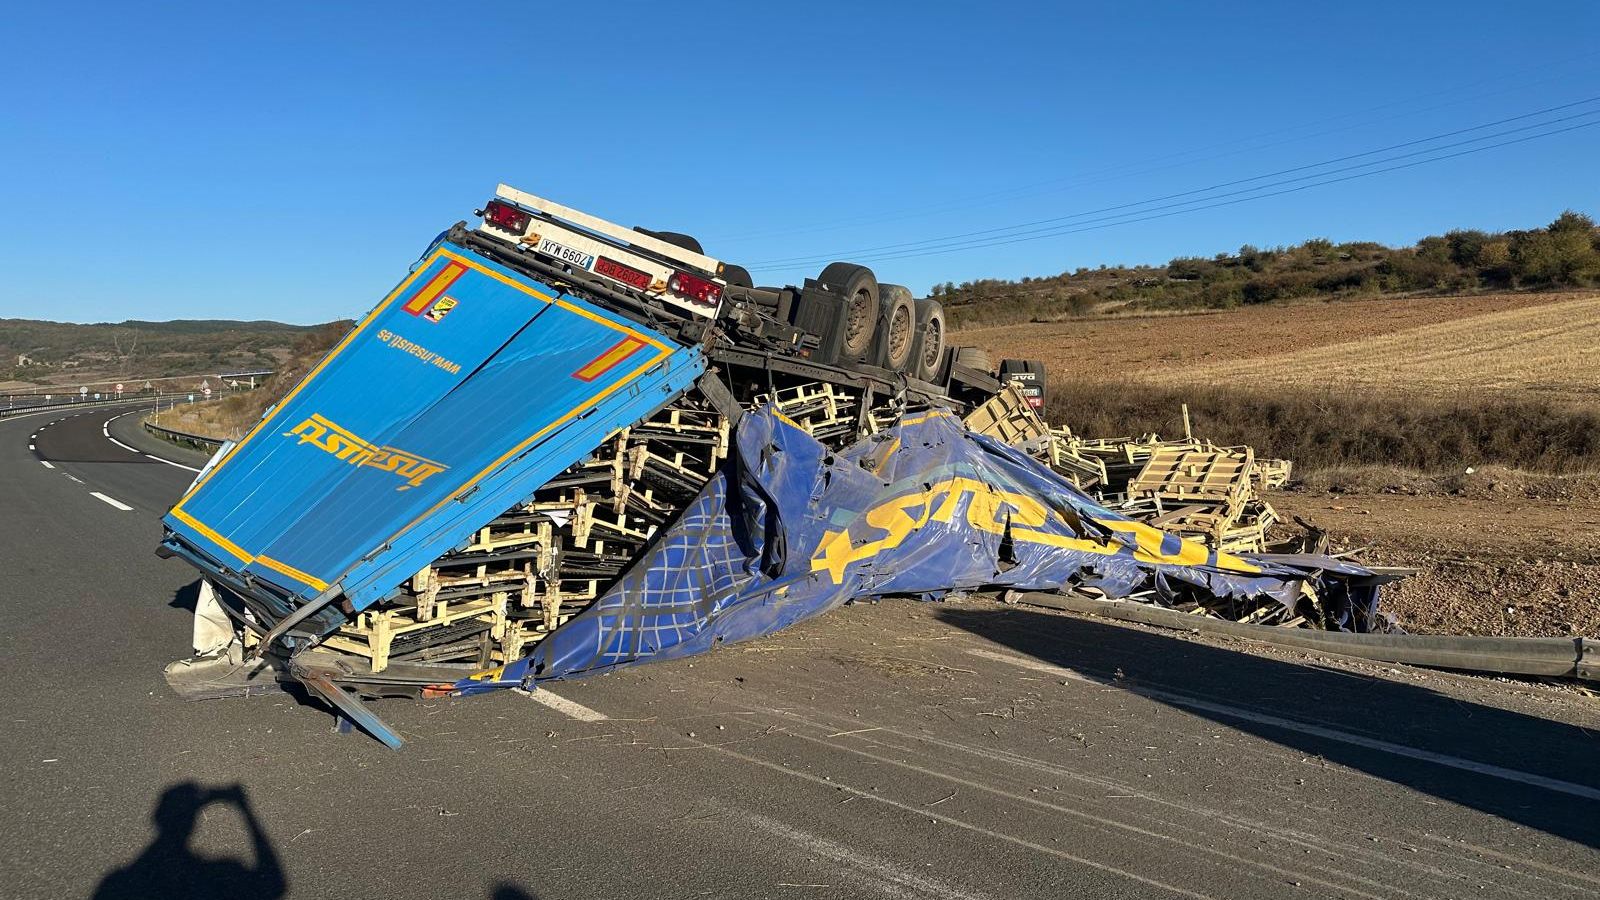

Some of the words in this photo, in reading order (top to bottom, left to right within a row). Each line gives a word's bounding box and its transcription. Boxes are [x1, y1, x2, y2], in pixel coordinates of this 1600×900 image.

[542, 240, 562, 256] MJX
[563, 248, 588, 266] 7099
[377, 329, 462, 375] www.insausti.es
